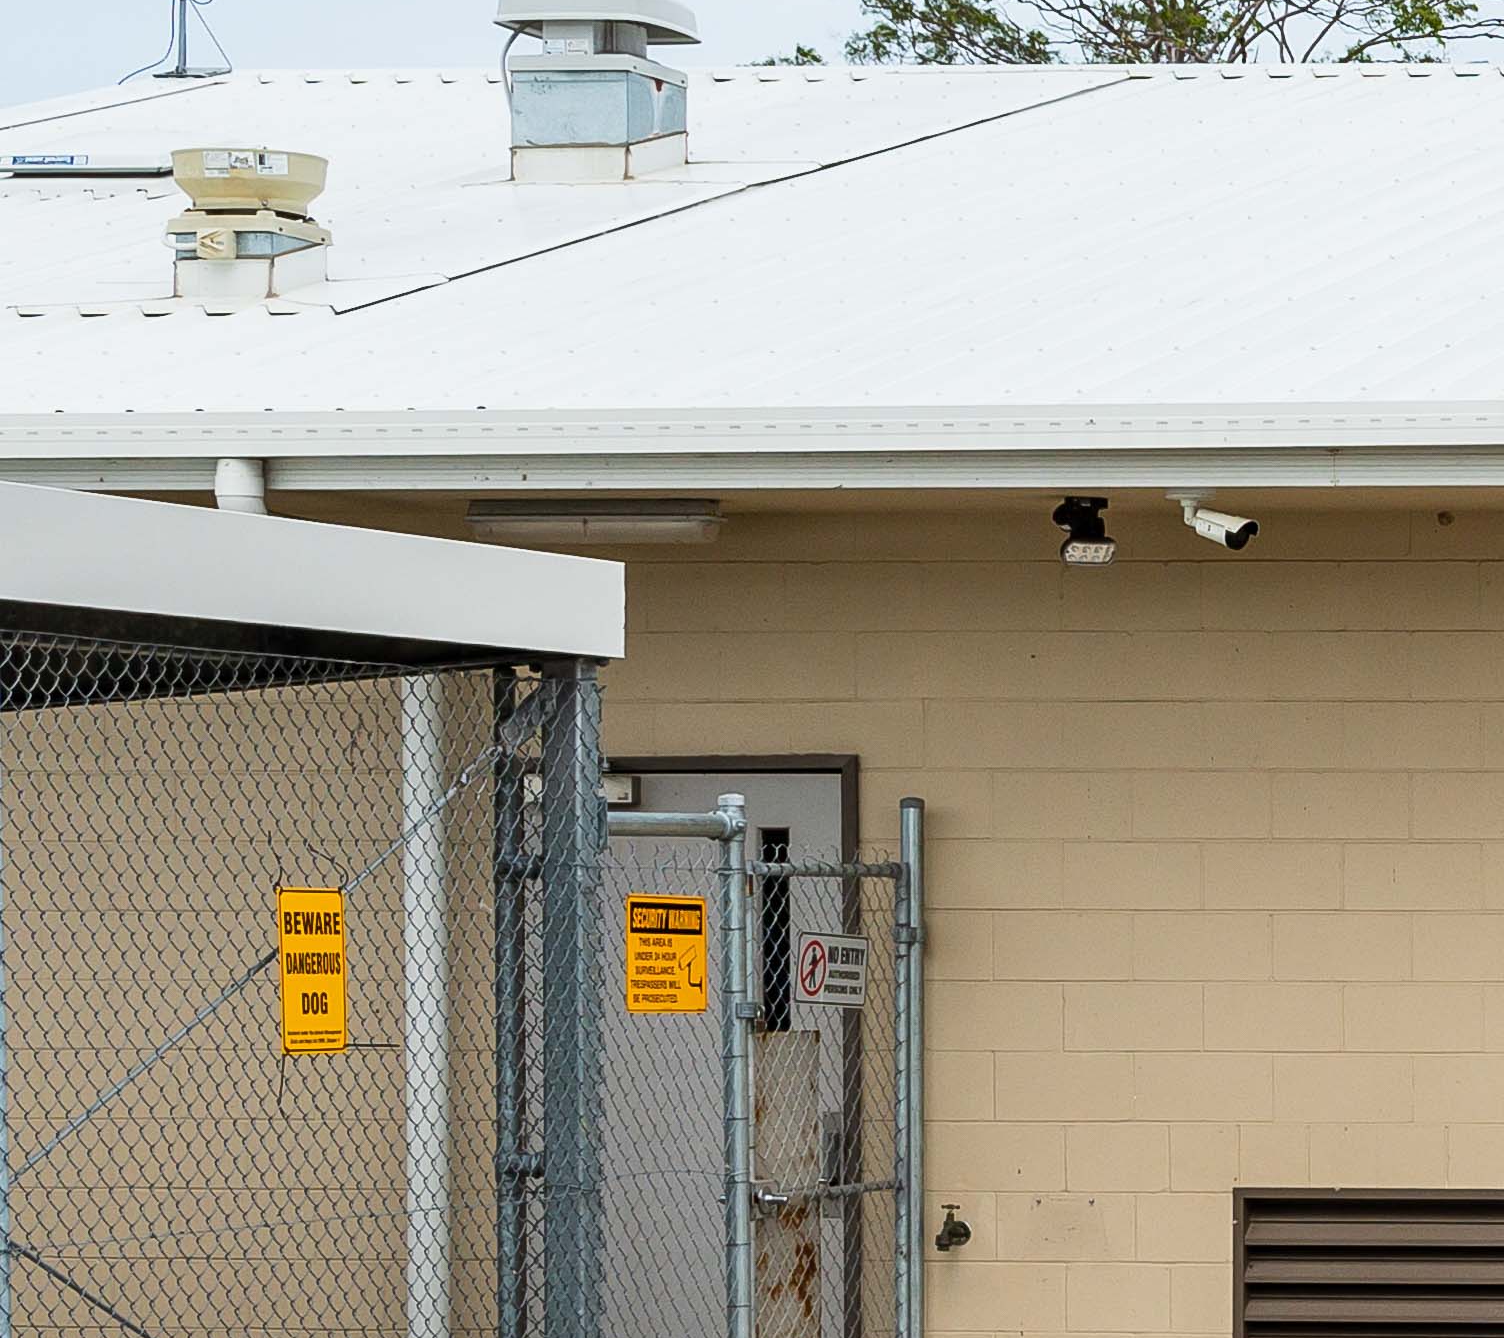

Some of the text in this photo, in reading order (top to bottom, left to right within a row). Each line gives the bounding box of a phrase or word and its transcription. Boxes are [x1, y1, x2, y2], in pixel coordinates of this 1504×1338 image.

[284, 911, 341, 935] BEWARE
[633, 908, 667, 928] SECURITY
[652, 938, 667, 947] AREA
[286, 952, 341, 975] DANGEROUS
[828, 946, 866, 966] NO ENTRY
[301, 991, 329, 1015] DOG
